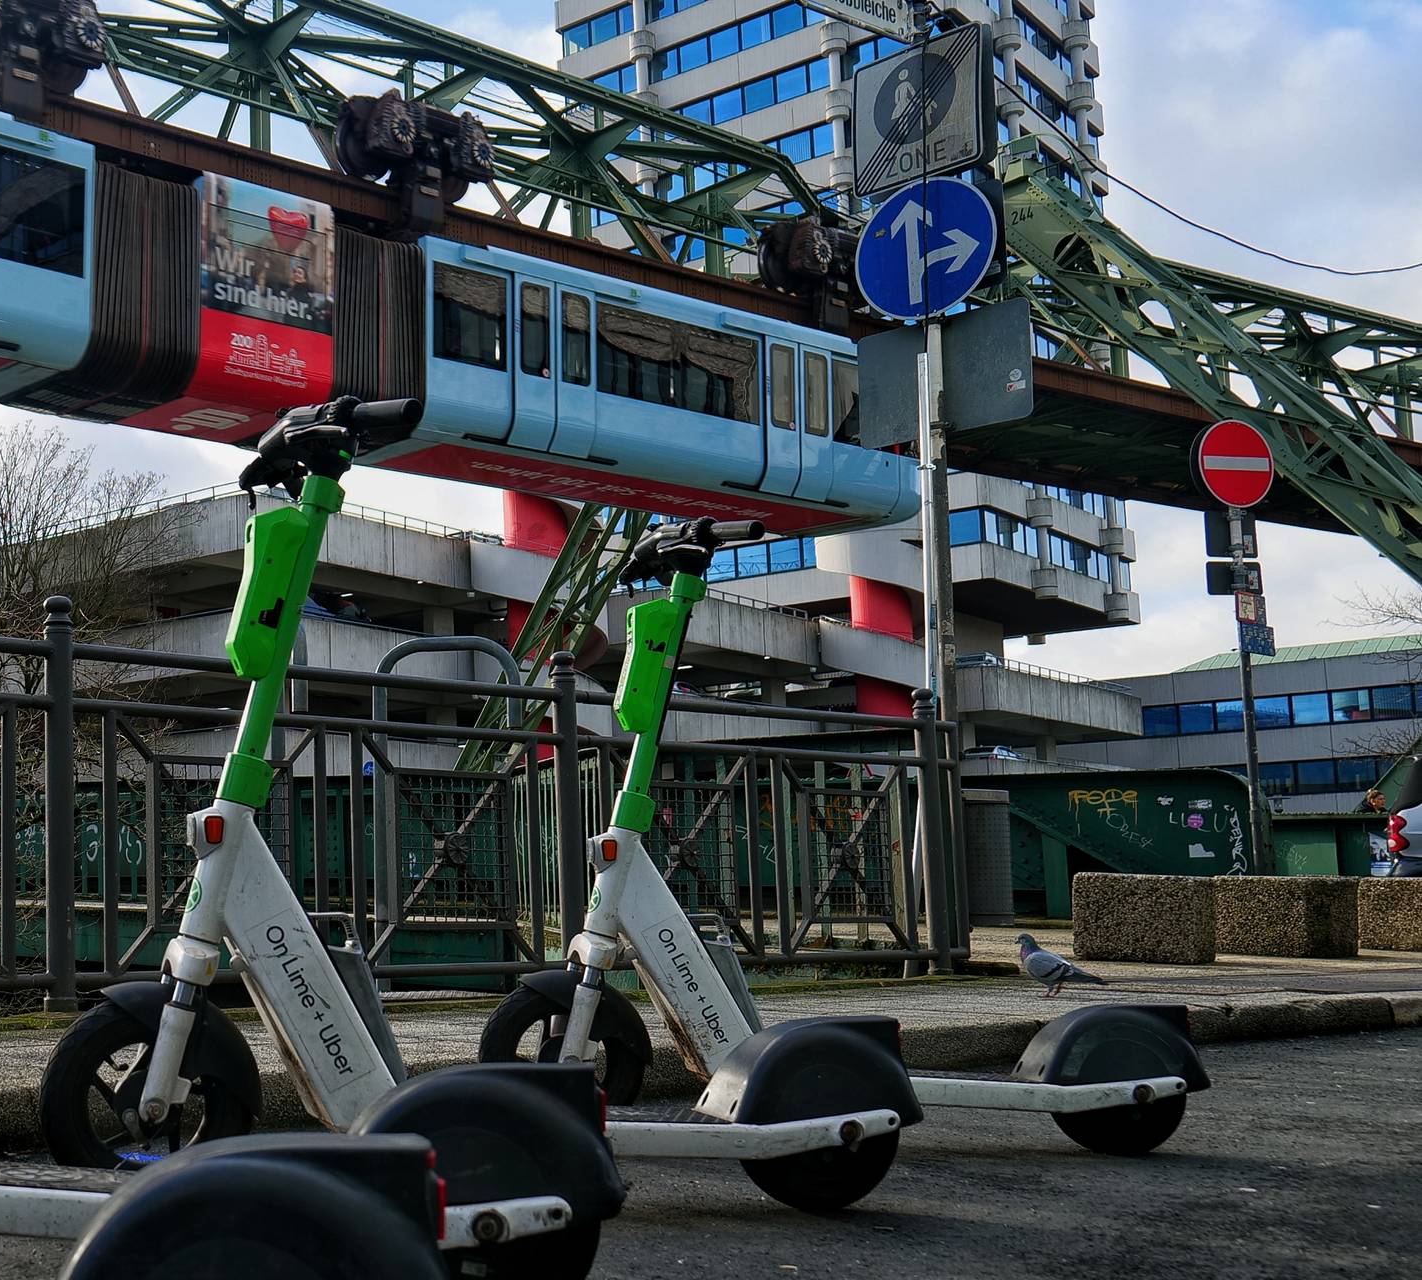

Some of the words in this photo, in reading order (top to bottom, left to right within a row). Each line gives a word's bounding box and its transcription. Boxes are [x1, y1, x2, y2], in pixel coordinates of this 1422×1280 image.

[886, 139, 947, 178] ZONE
[1011, 206, 1034, 225] 244
[215, 246, 255, 277] Wir
[214, 275, 262, 308] sind
[266, 287, 313, 320] hier.
[230, 332, 253, 349] 200
[266, 925, 288, 958] On
[659, 928, 677, 954] On
[282, 957, 315, 1008] Lime
[671, 952, 699, 993] Lime
[697, 994, 707, 1004] +
[314, 1011, 325, 1022] +
[701, 1005, 729, 1044] Uber
[319, 1024, 353, 1075] Uber
